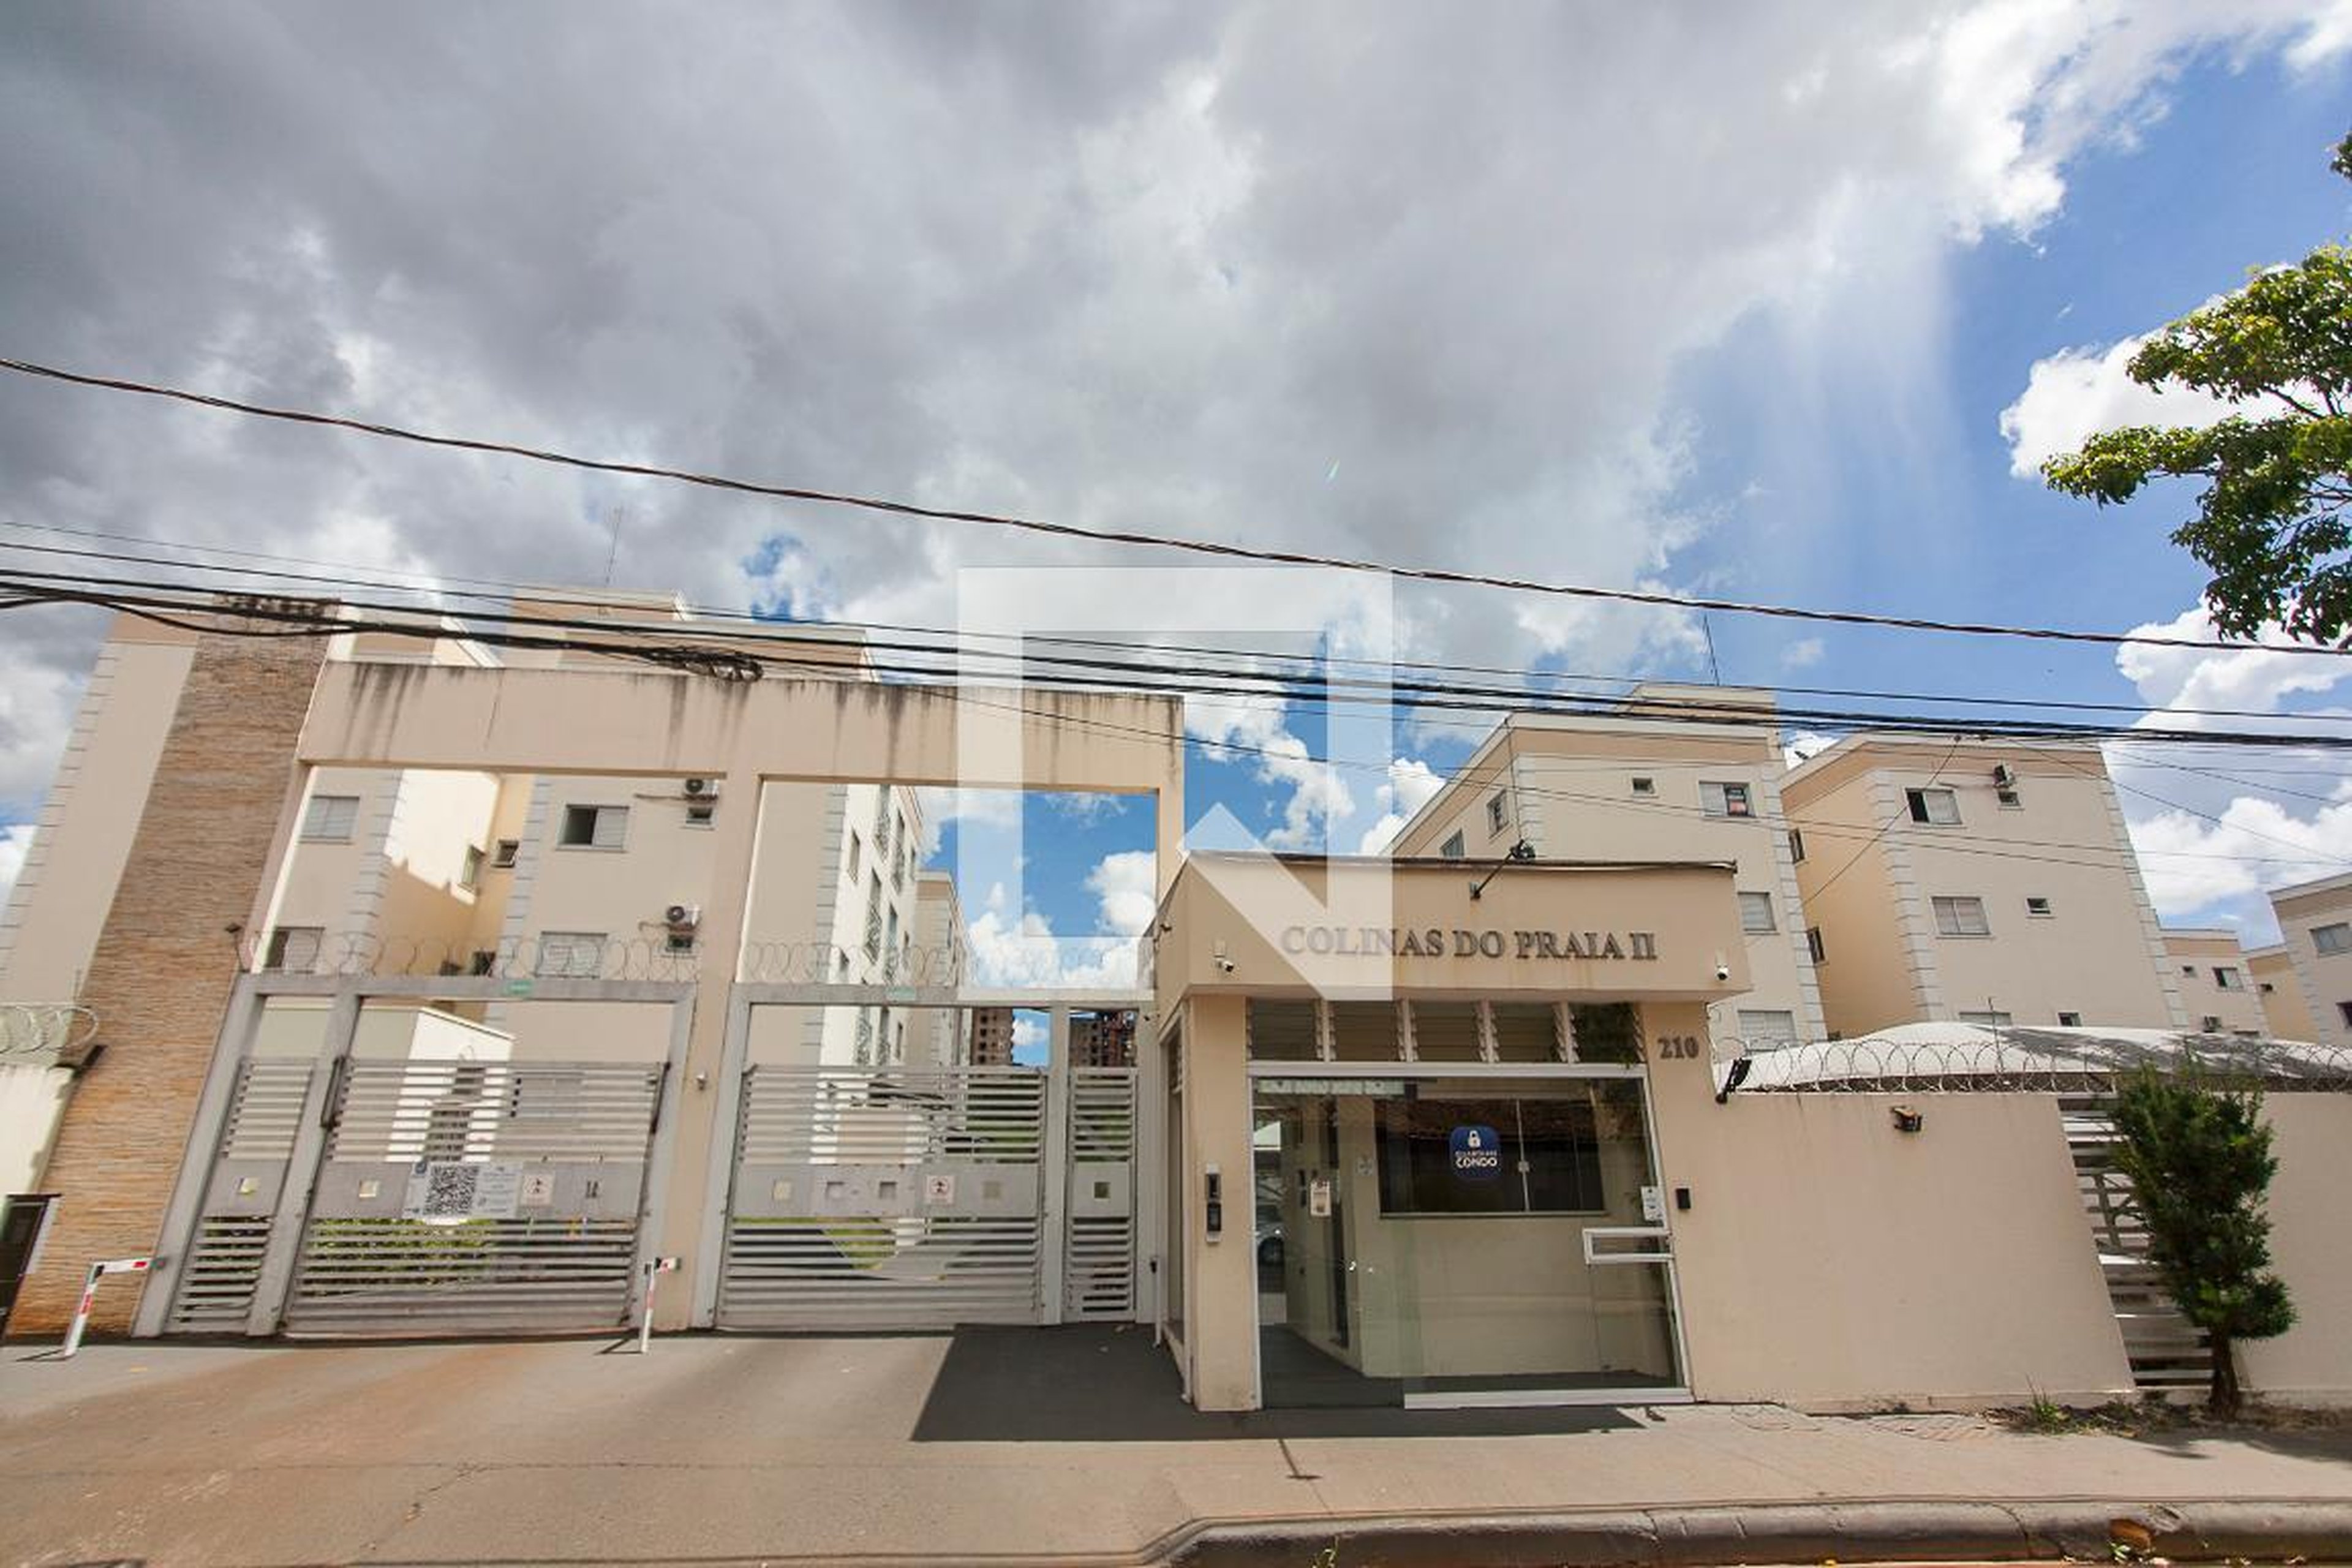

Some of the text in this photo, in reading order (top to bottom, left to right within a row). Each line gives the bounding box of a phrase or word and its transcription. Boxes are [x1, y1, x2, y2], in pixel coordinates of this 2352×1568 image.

[1281, 925, 1657, 960] COLINAS DO PRAIA II
[1657, 1035, 1699, 1060] 210
